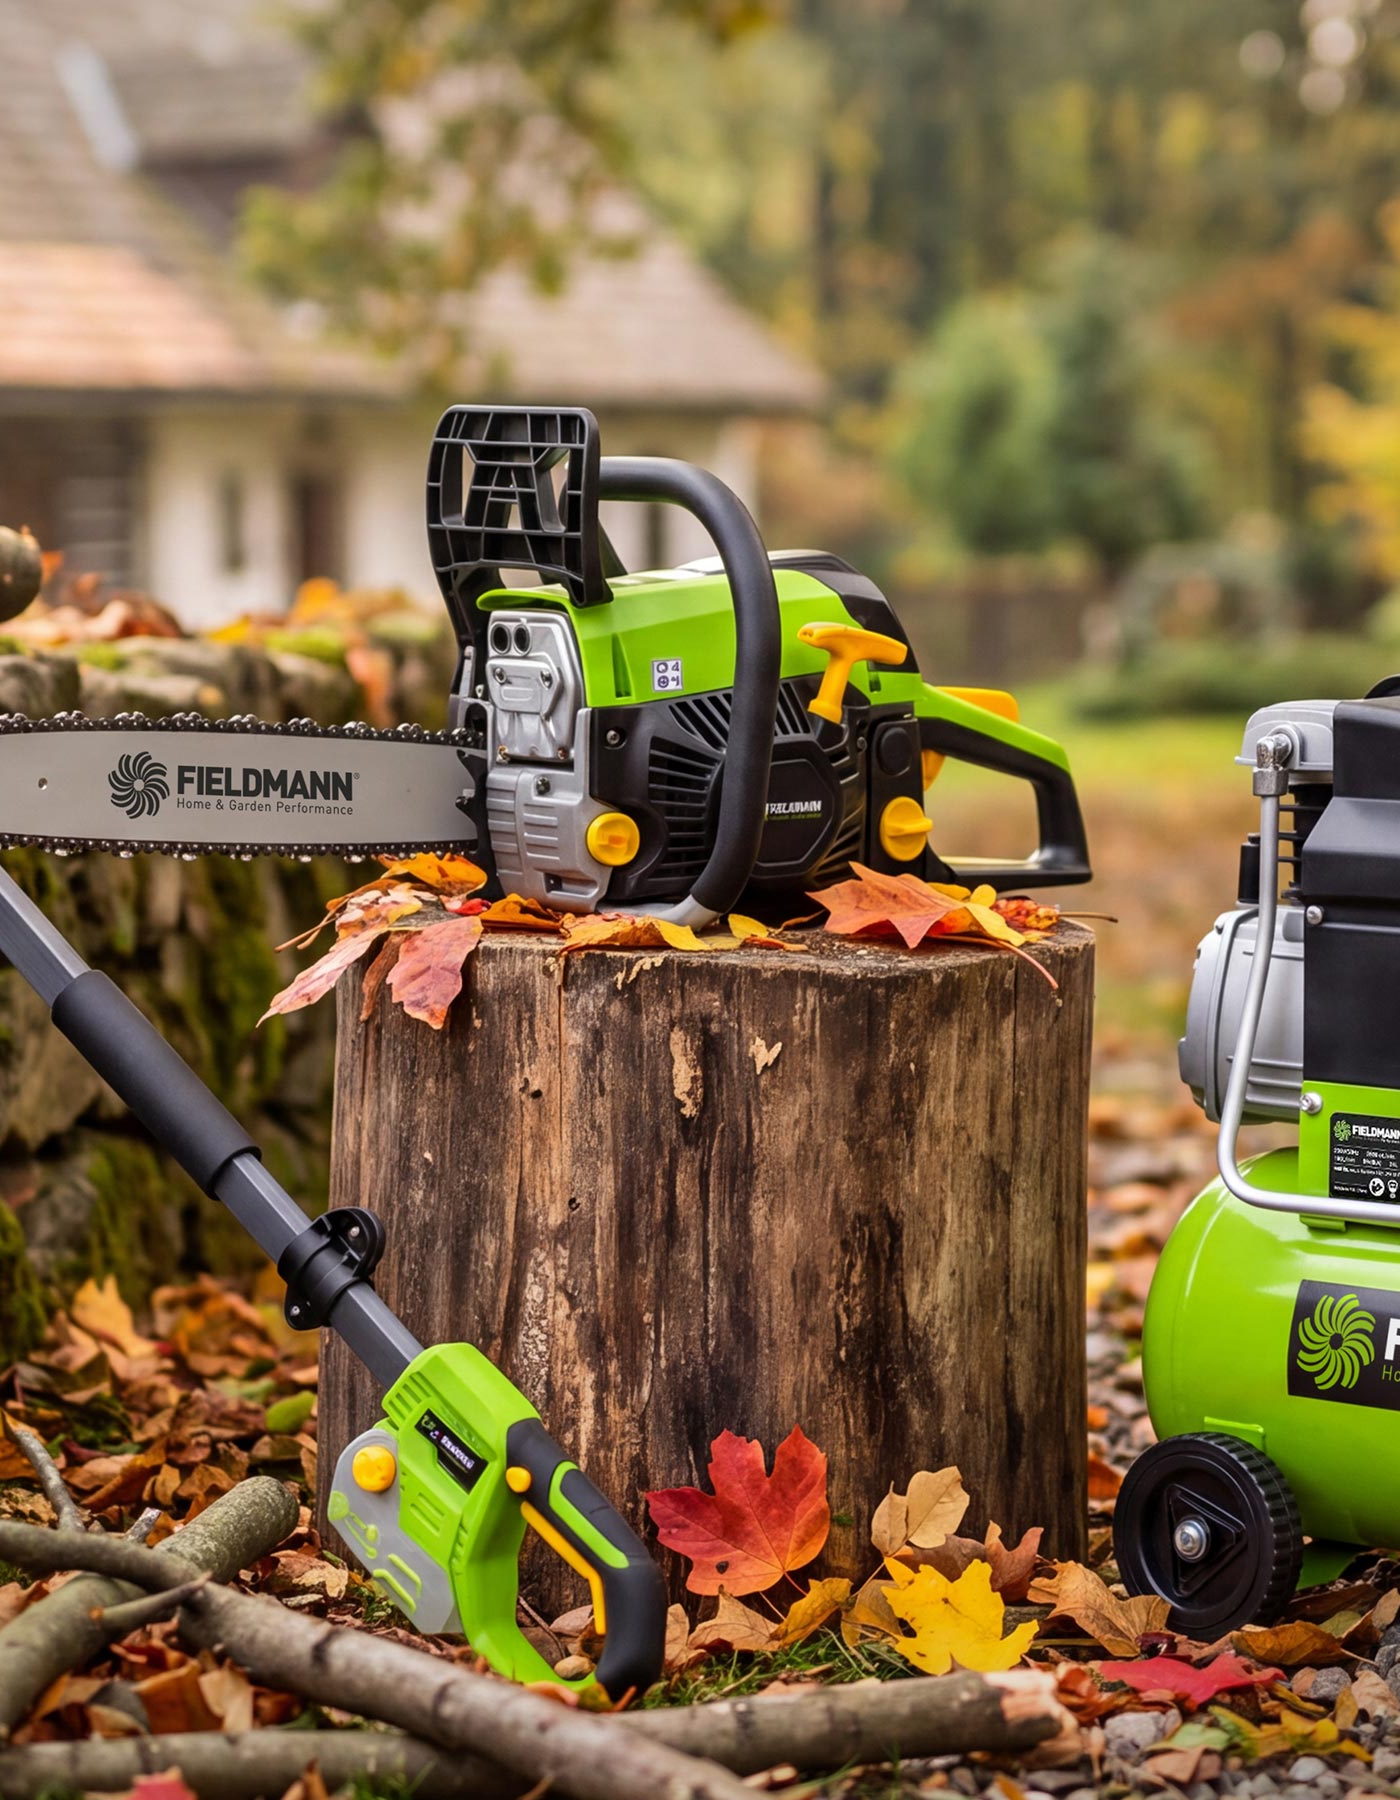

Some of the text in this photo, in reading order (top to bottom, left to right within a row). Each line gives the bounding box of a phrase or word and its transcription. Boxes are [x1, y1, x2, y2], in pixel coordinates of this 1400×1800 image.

[177, 798, 353, 815] Home & Garden Performance
